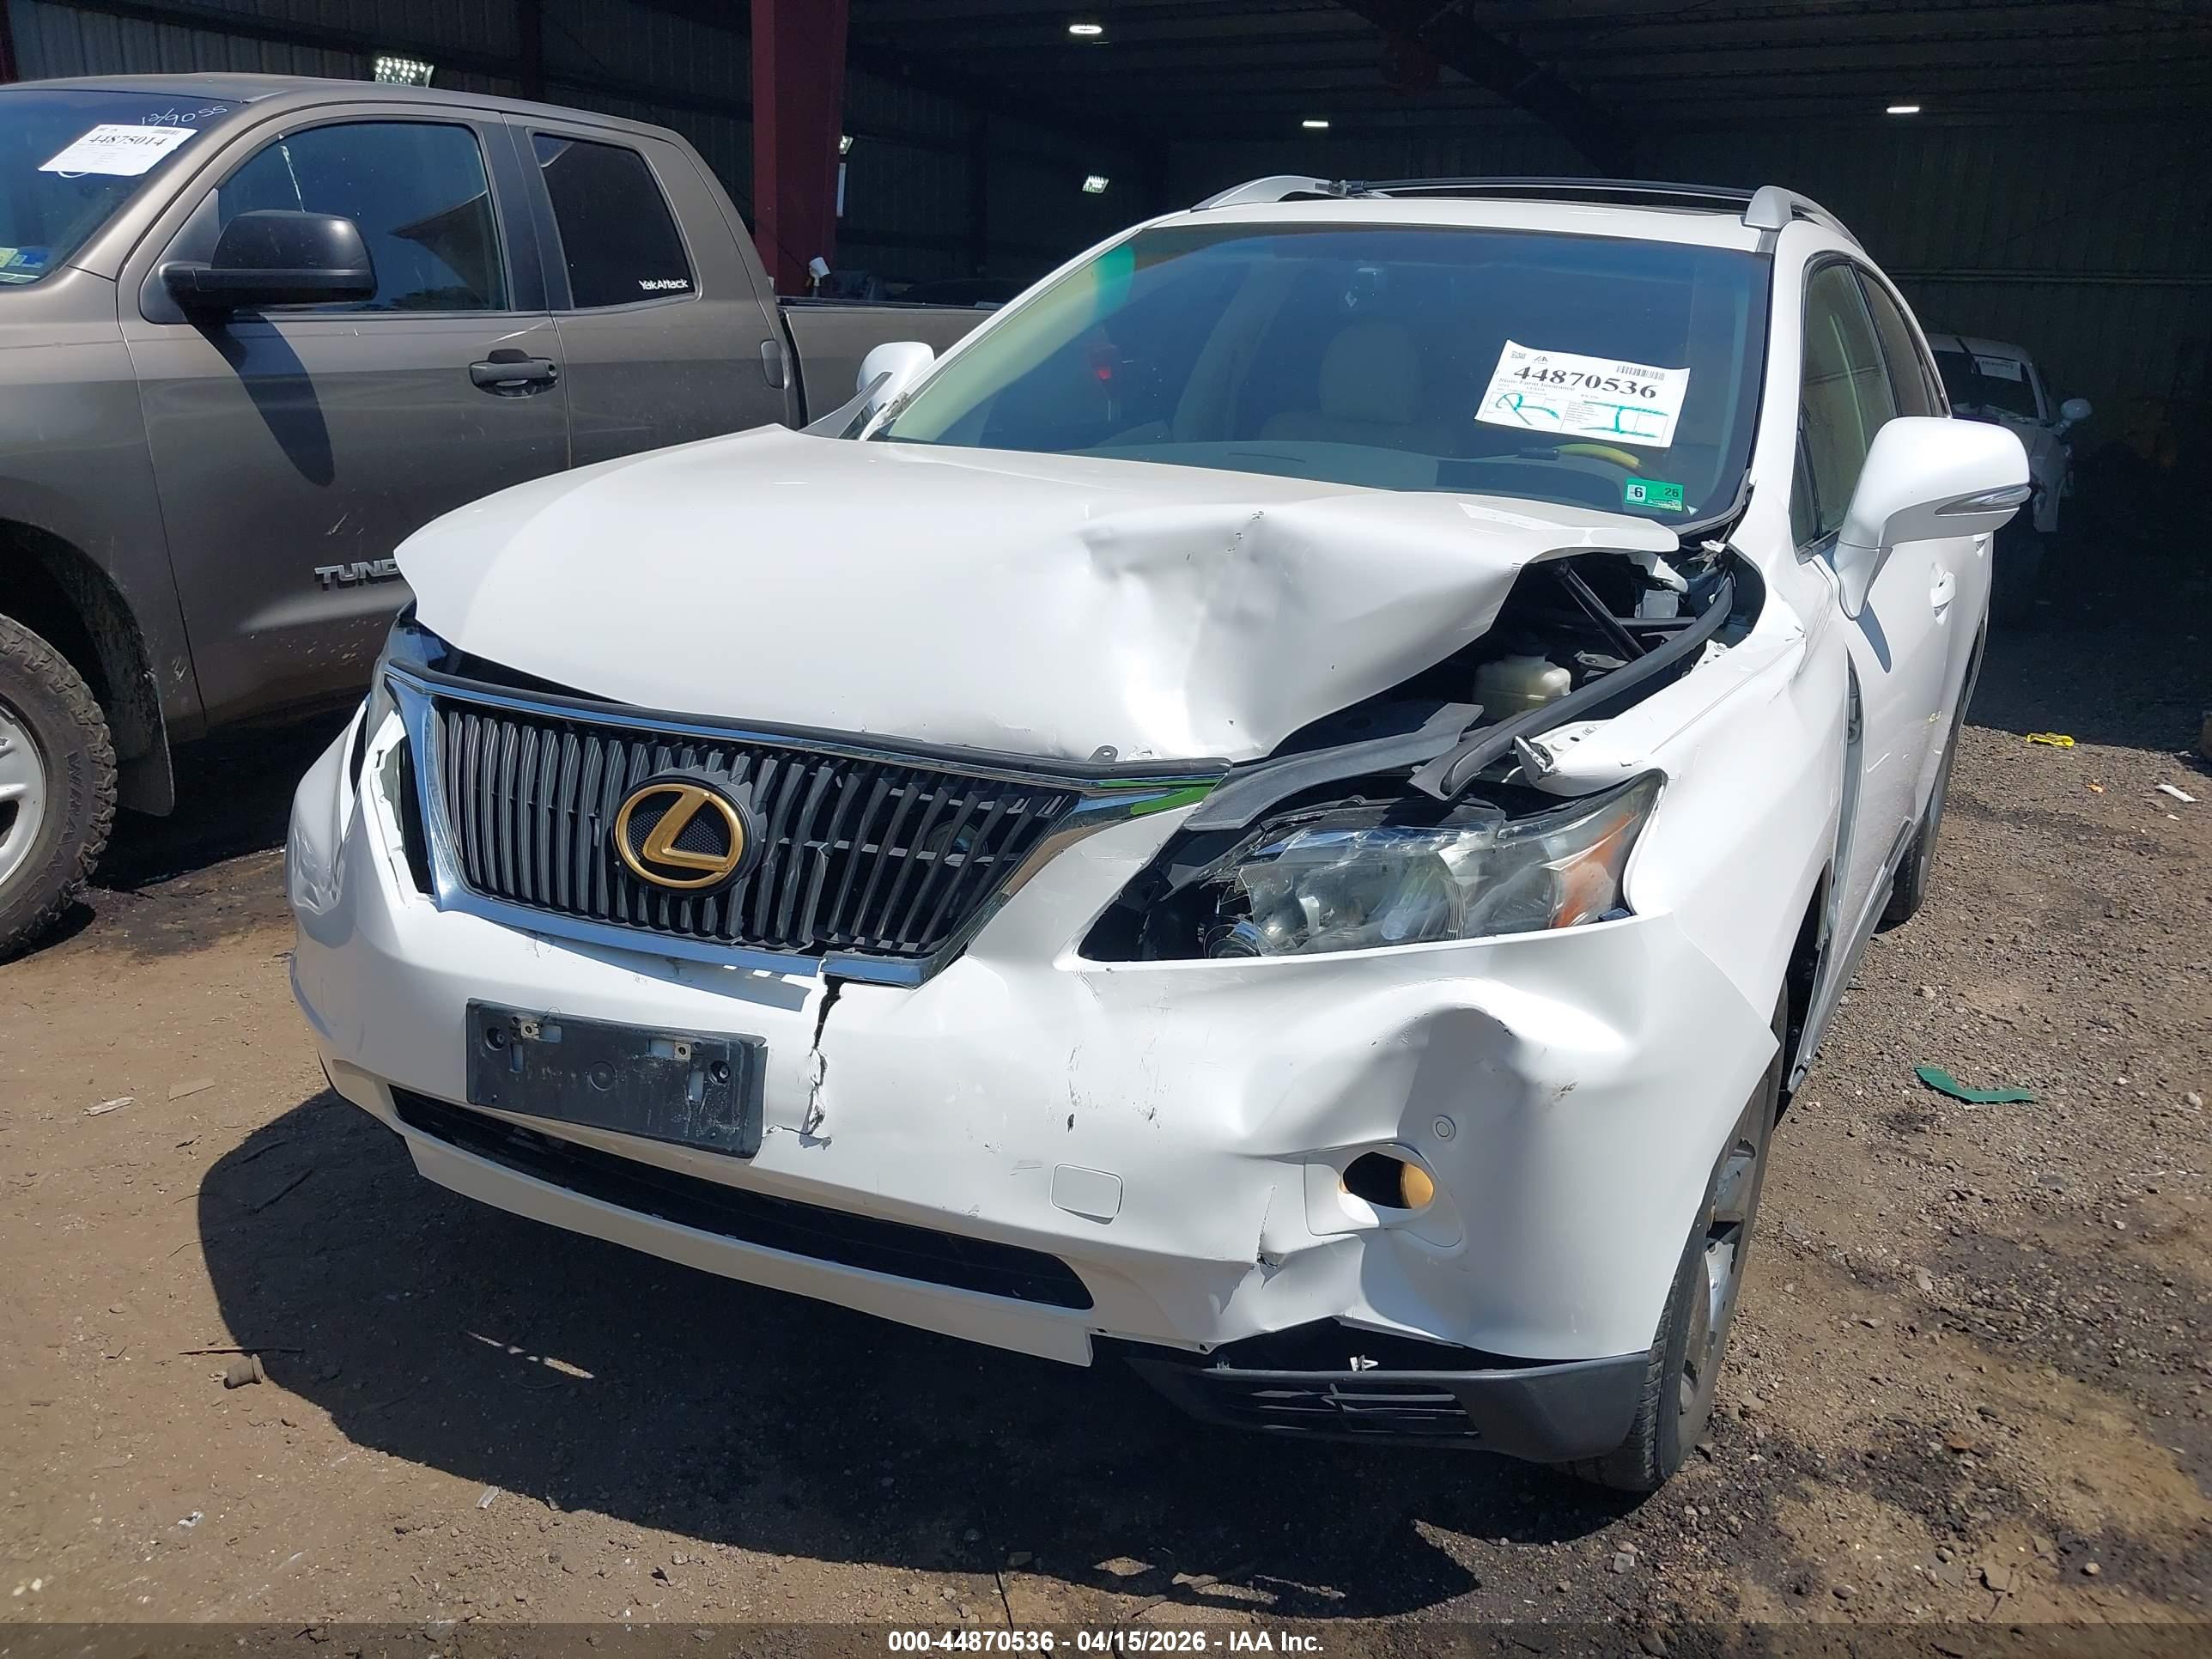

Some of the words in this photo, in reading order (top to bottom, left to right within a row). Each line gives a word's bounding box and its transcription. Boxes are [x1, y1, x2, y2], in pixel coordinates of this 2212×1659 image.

[89, 135, 168, 146] 44875014
[638, 277, 689, 290] YakAttack
[1513, 366, 1659, 399] 44870536
[1634, 487, 1644, 498] 6
[1664, 487, 1680, 498] 26
